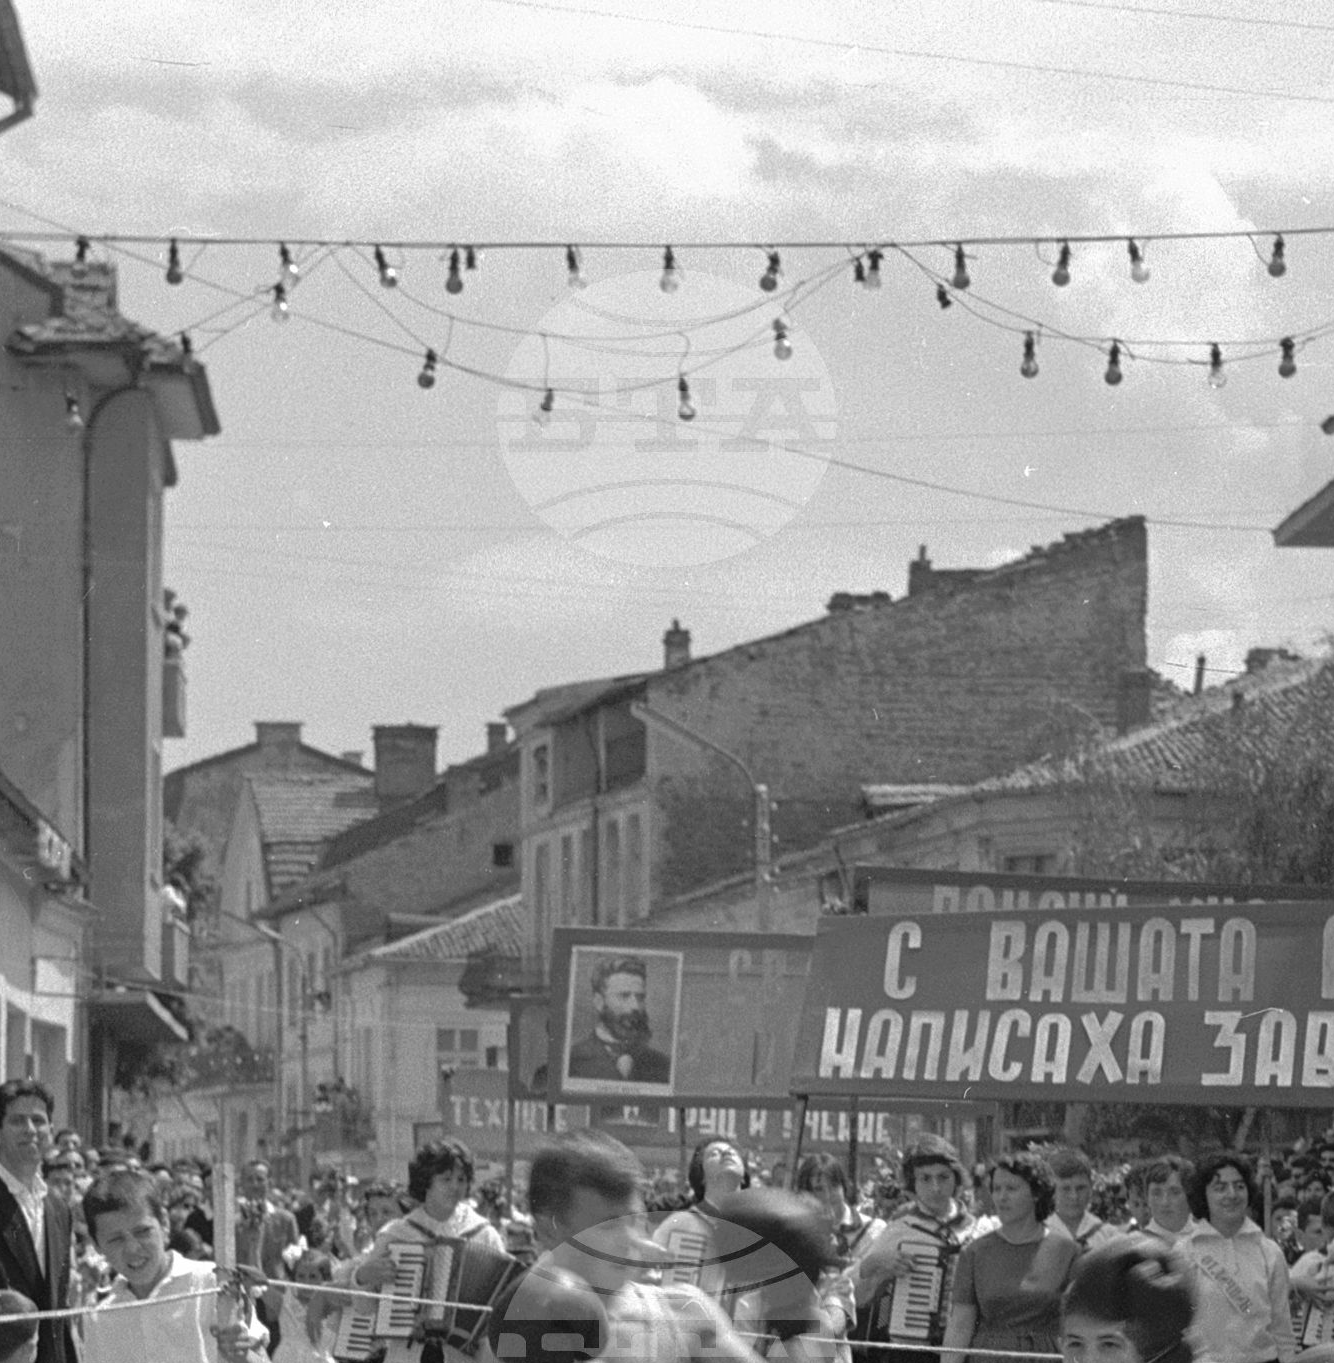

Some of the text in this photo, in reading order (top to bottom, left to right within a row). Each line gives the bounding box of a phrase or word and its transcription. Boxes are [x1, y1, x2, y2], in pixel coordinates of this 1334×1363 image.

[882, 920, 923, 1001] С
[985, 917, 1257, 1005] ВАШАТА
[817, 1006, 1167, 1085] НАПИСАХА
